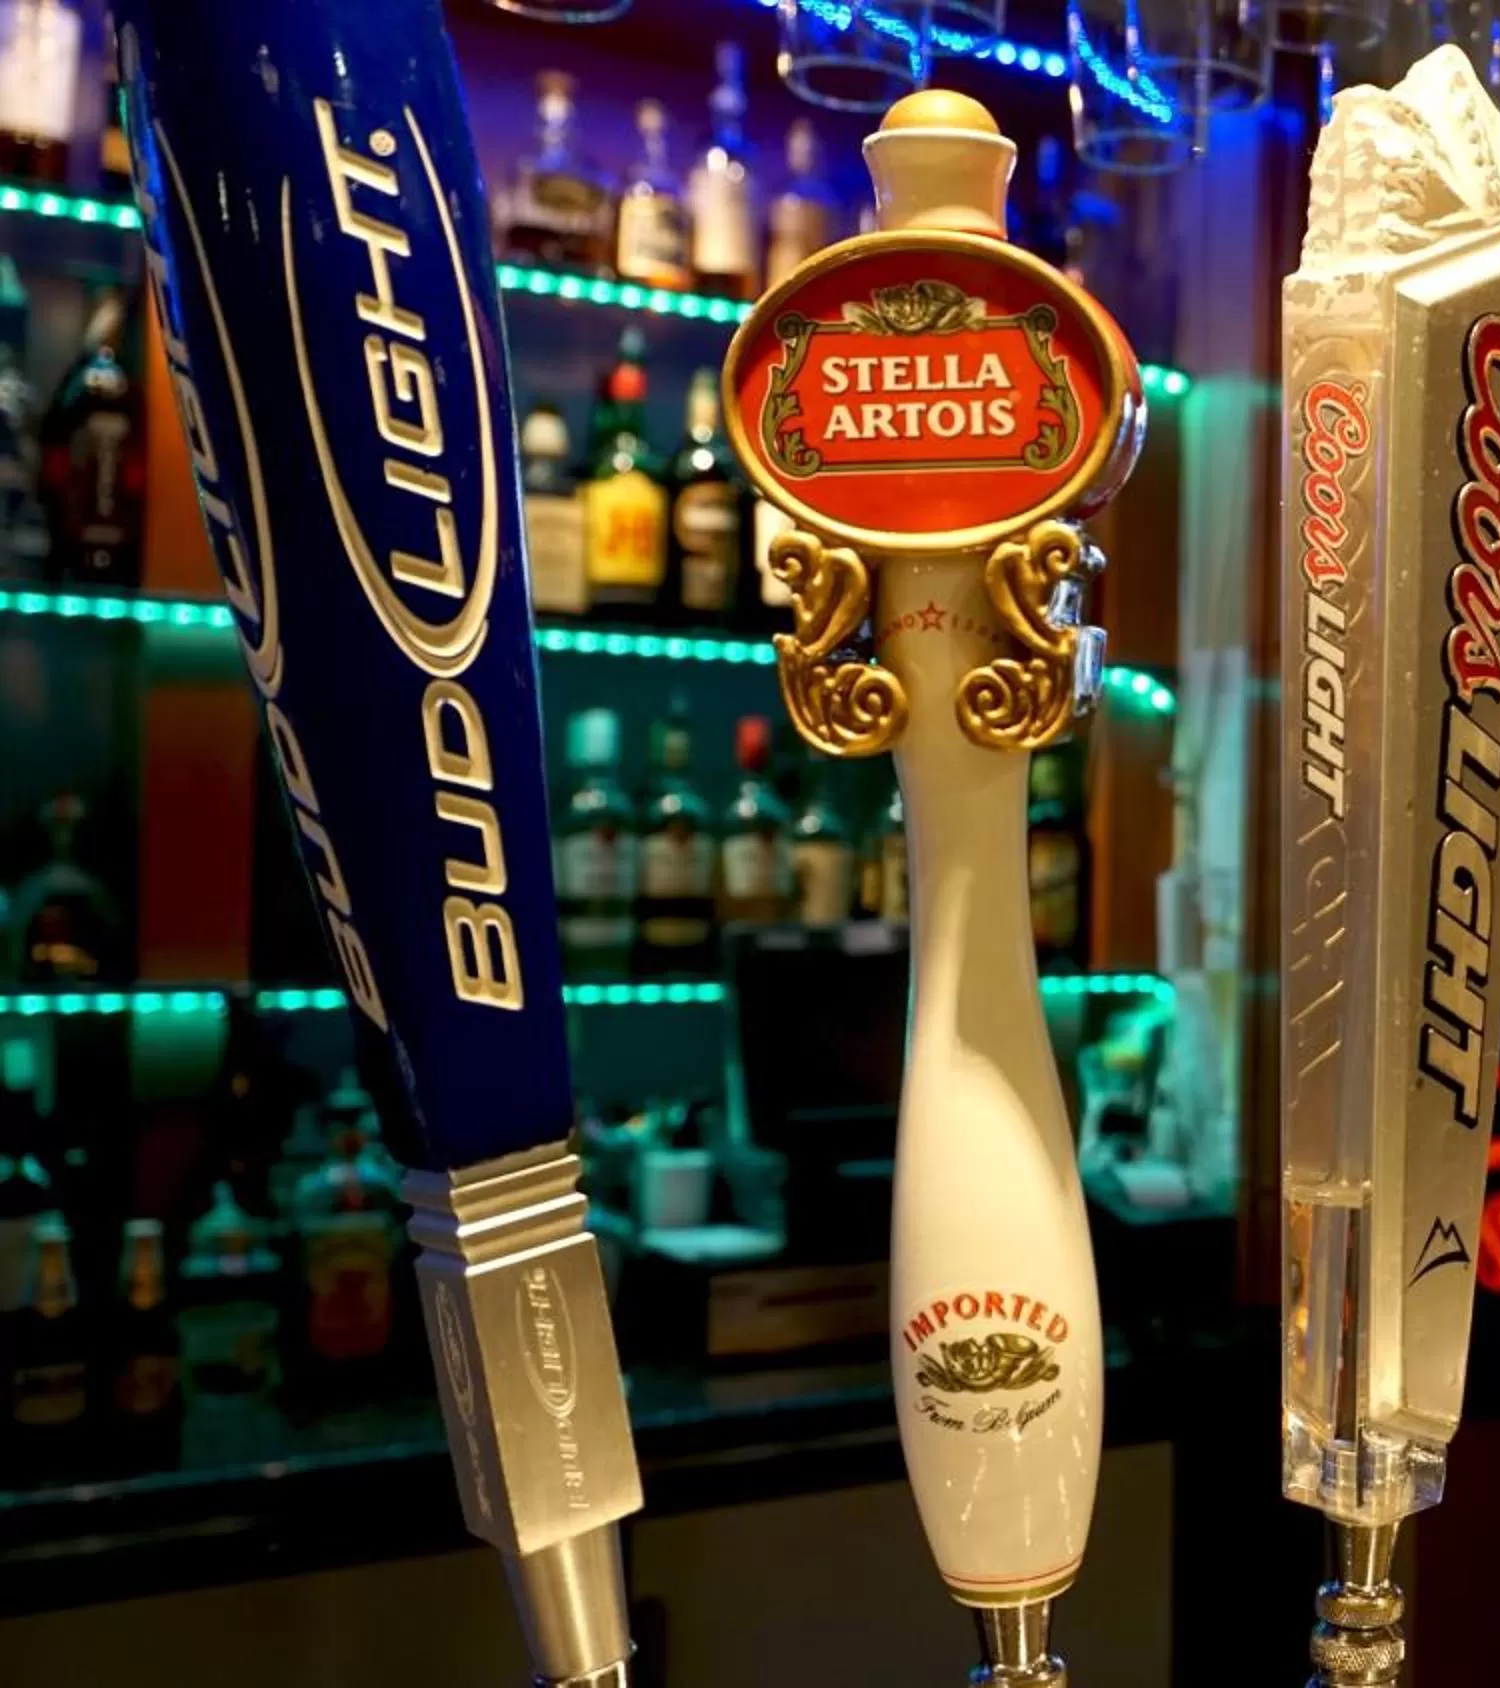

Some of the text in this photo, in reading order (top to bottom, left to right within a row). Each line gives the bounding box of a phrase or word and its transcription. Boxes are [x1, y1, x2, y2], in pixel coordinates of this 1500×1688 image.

[821, 353, 1013, 394] STELLA
[822, 399, 1017, 441] ARTOIS
[1304, 381, 1371, 821] Coors LIGHT
[267, 702, 389, 1034] BUD
[422, 679, 525, 1011] BUD
[902, 1289, 1069, 1352] IMPORTED
